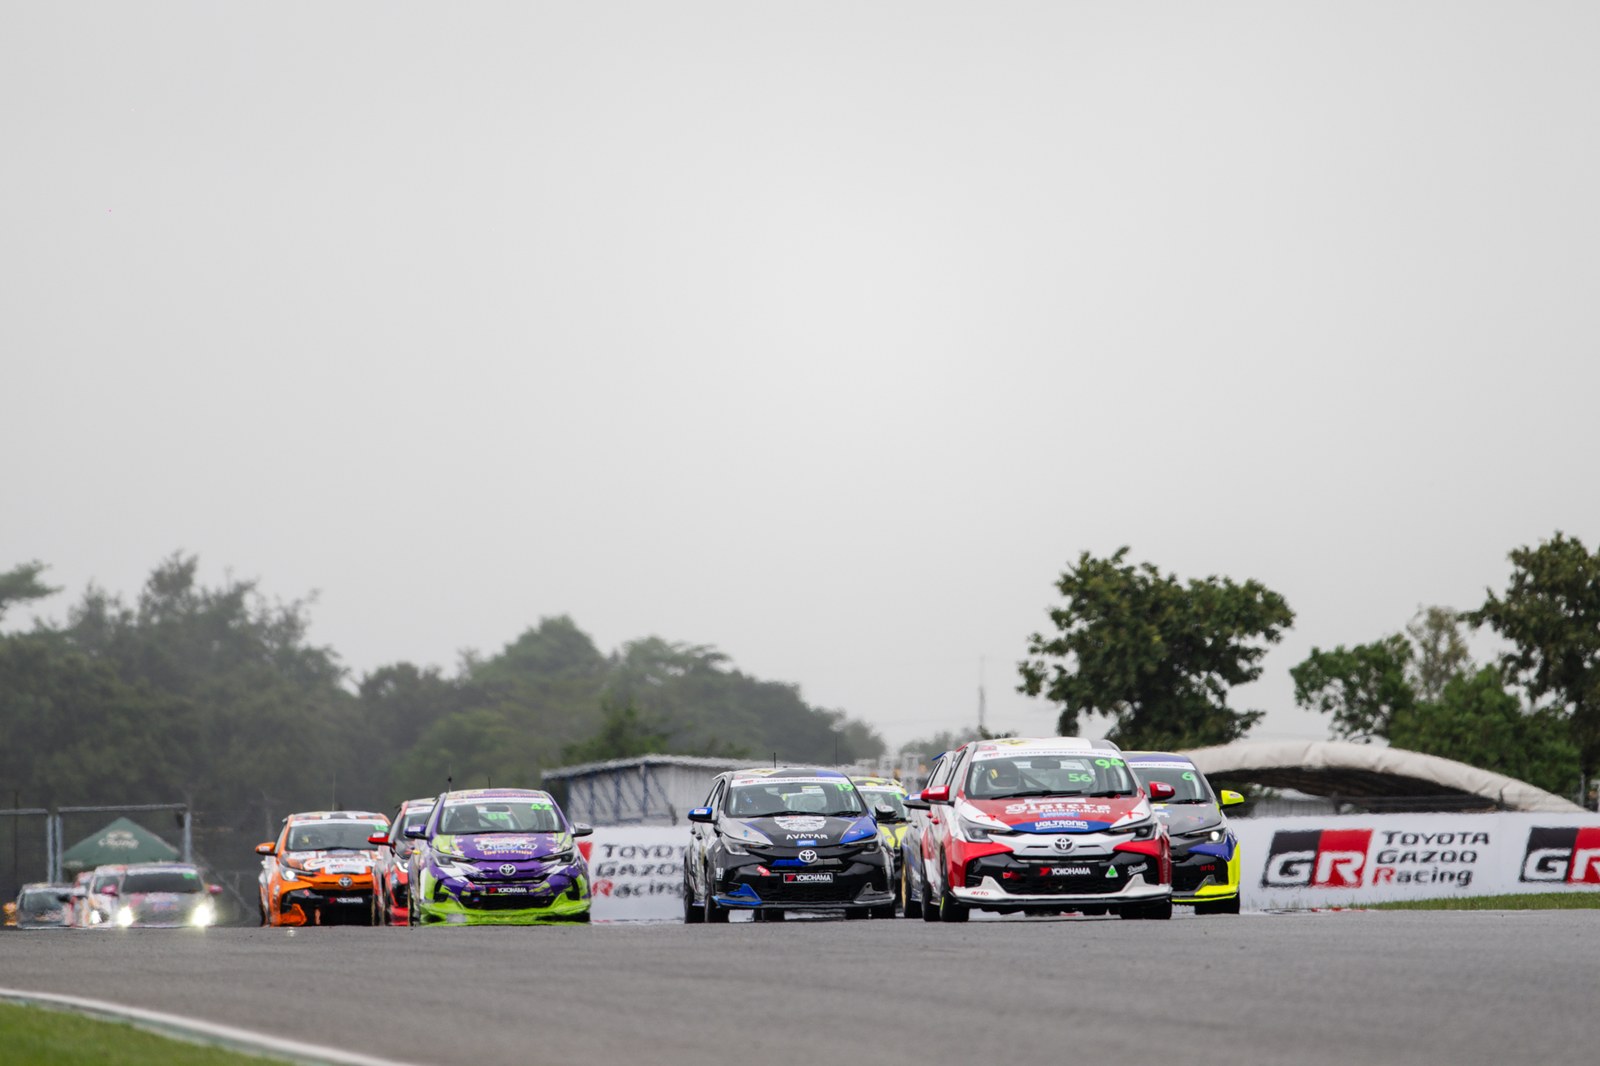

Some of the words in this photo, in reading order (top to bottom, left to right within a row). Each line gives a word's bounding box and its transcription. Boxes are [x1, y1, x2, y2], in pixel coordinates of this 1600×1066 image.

[1095, 759, 1125, 769] 94
[1068, 774, 1092, 782] 56
[1182, 772, 1193, 780] 6
[1382, 831, 1490, 845] TOYOTA
[1376, 850, 1477, 864] GAZOO
[1051, 867, 1091, 876] YOKOHAMA
[1264, 850, 1366, 885] GR
[1372, 867, 1473, 886] Racing
